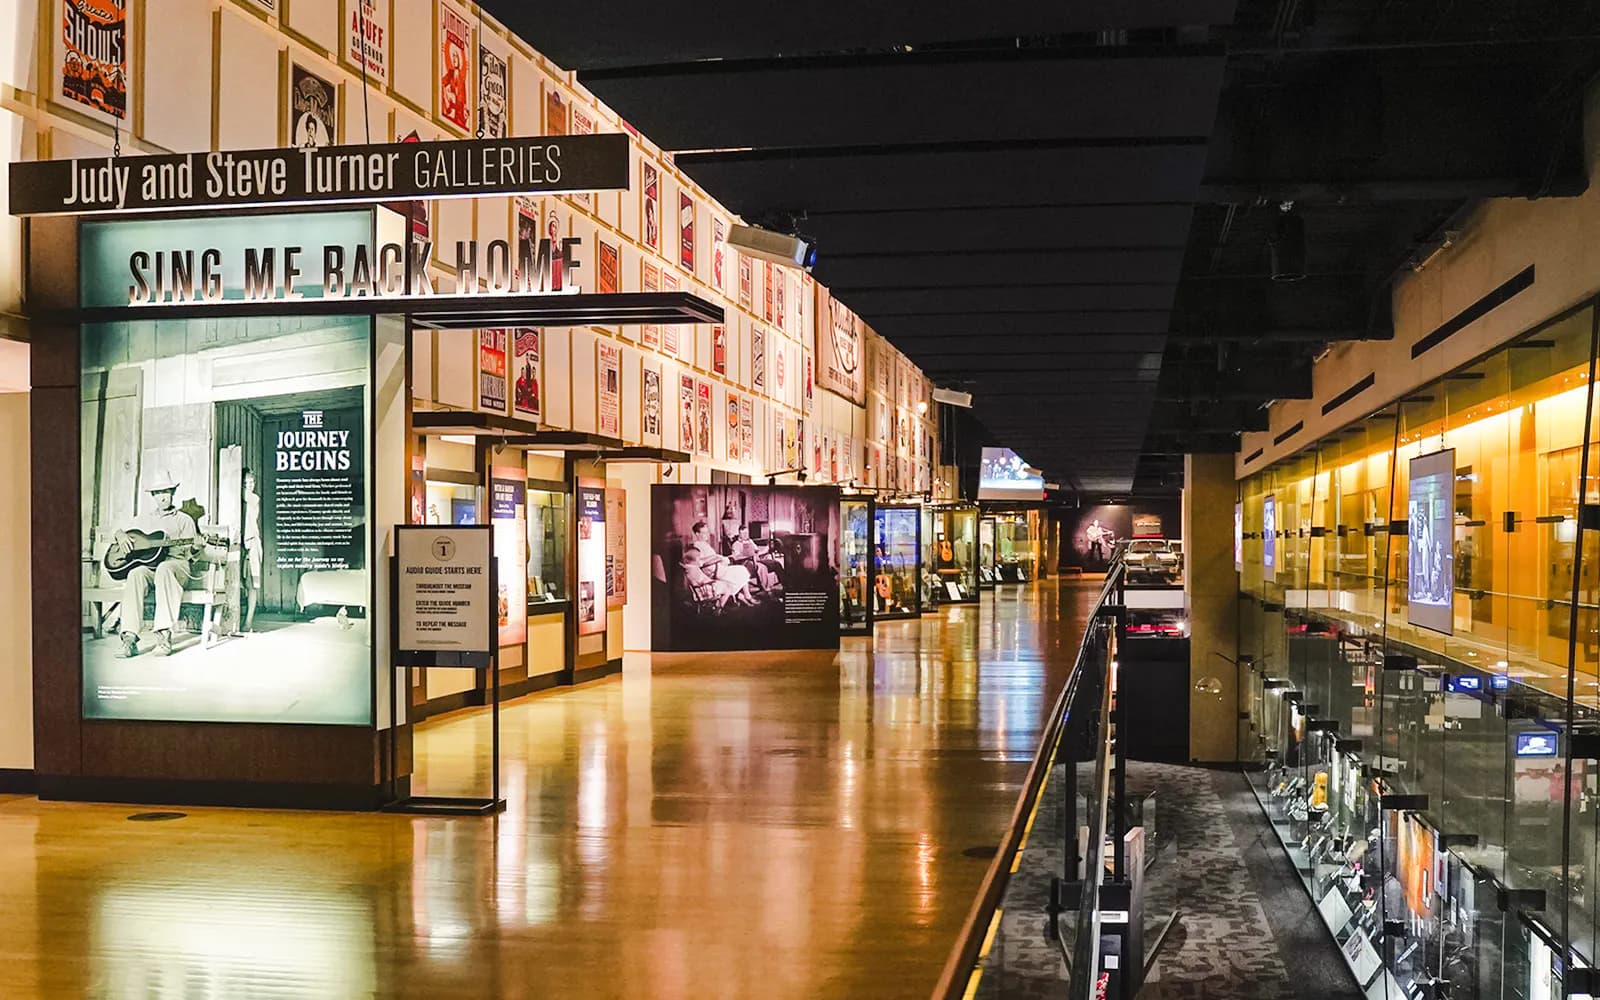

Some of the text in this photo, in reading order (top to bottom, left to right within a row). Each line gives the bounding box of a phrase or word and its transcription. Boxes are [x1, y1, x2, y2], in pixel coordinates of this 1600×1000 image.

[64, 1, 121, 67] SHOWS
[352, 10, 384, 48] ACUFF
[352, 35, 383, 64] GOERNOR
[63, 144, 562, 209] Judy and Steve Turner GALLERIES
[128, 249, 225, 306] SING
[244, 246, 304, 301] ME
[323, 241, 435, 299] BACK
[456, 237, 582, 296] HOME
[302, 414, 323, 425] THE
[277, 430, 350, 448] JOURNEY
[276, 449, 351, 471] BEGINS
[440, 545, 447, 556] 1
[405, 566, 482, 575] AUDIO GUIDE STARTS HERE
